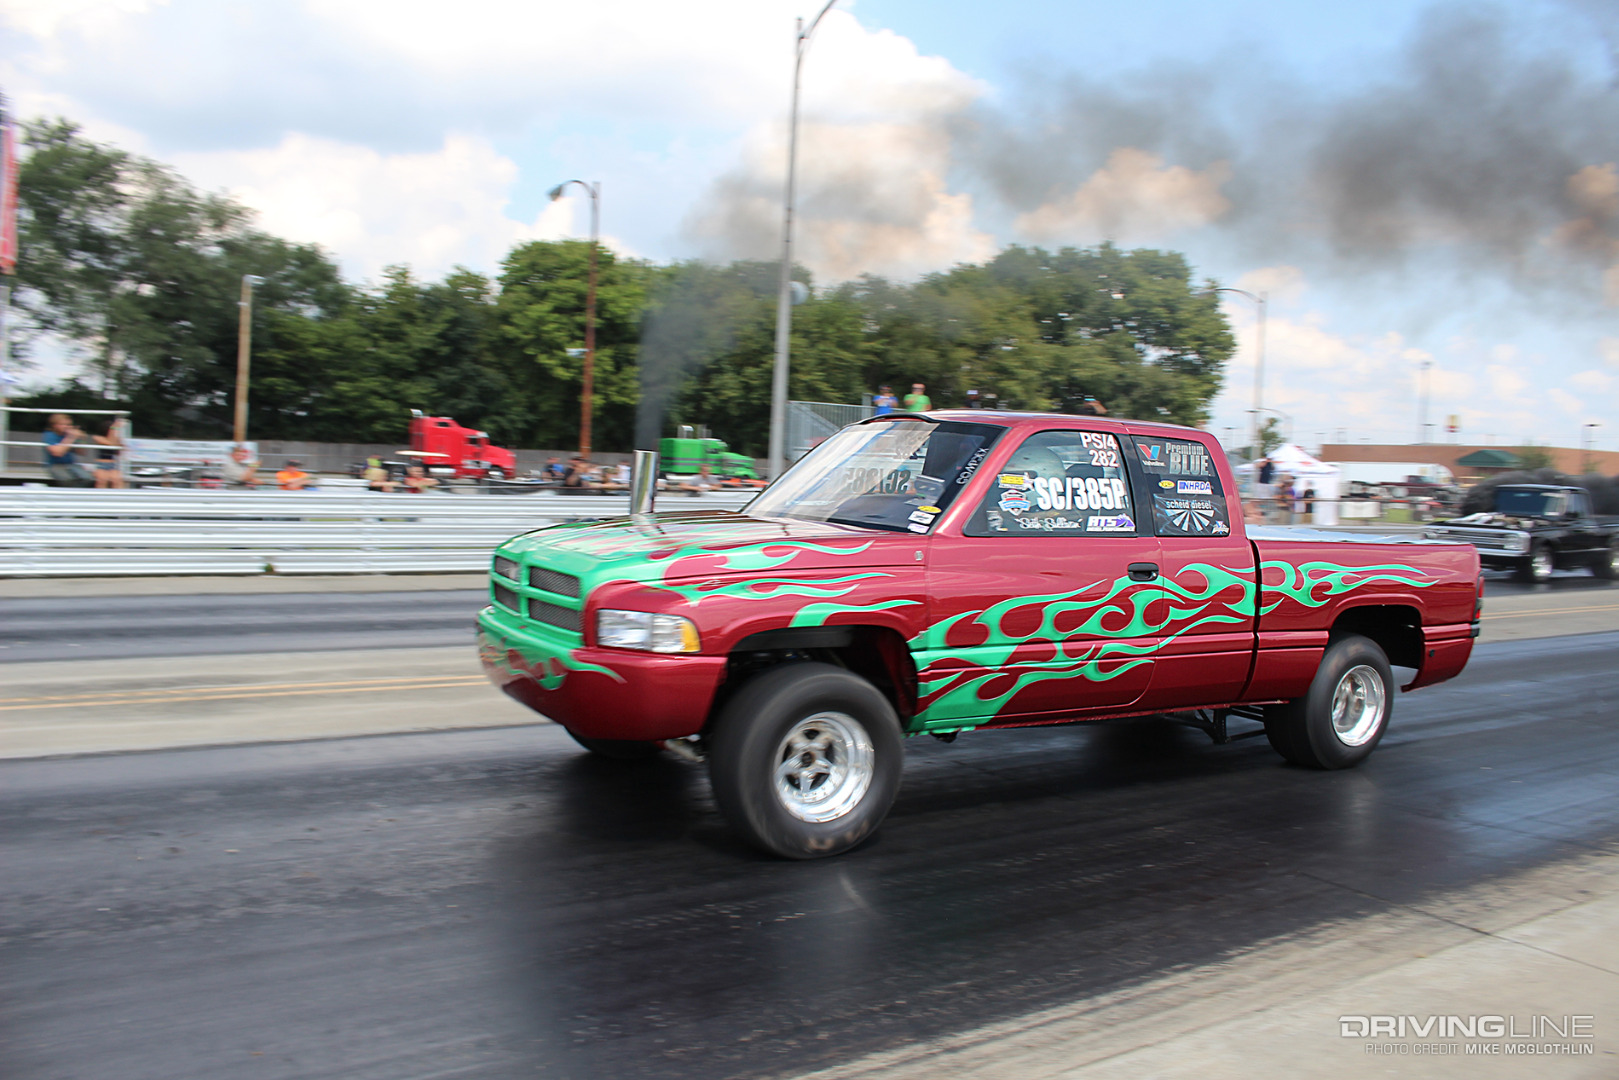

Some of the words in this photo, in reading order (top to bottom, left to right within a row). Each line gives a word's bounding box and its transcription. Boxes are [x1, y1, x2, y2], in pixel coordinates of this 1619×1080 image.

[1080, 432, 1118, 450] PS/4
[1165, 442, 1204, 455] Premium
[1089, 450, 1119, 467] 282
[1169, 452, 1209, 476] BLUE
[1183, 481, 1211, 491] NHRDA
[1166, 500, 1190, 509] scheid
[1191, 500, 1212, 509] diesel
